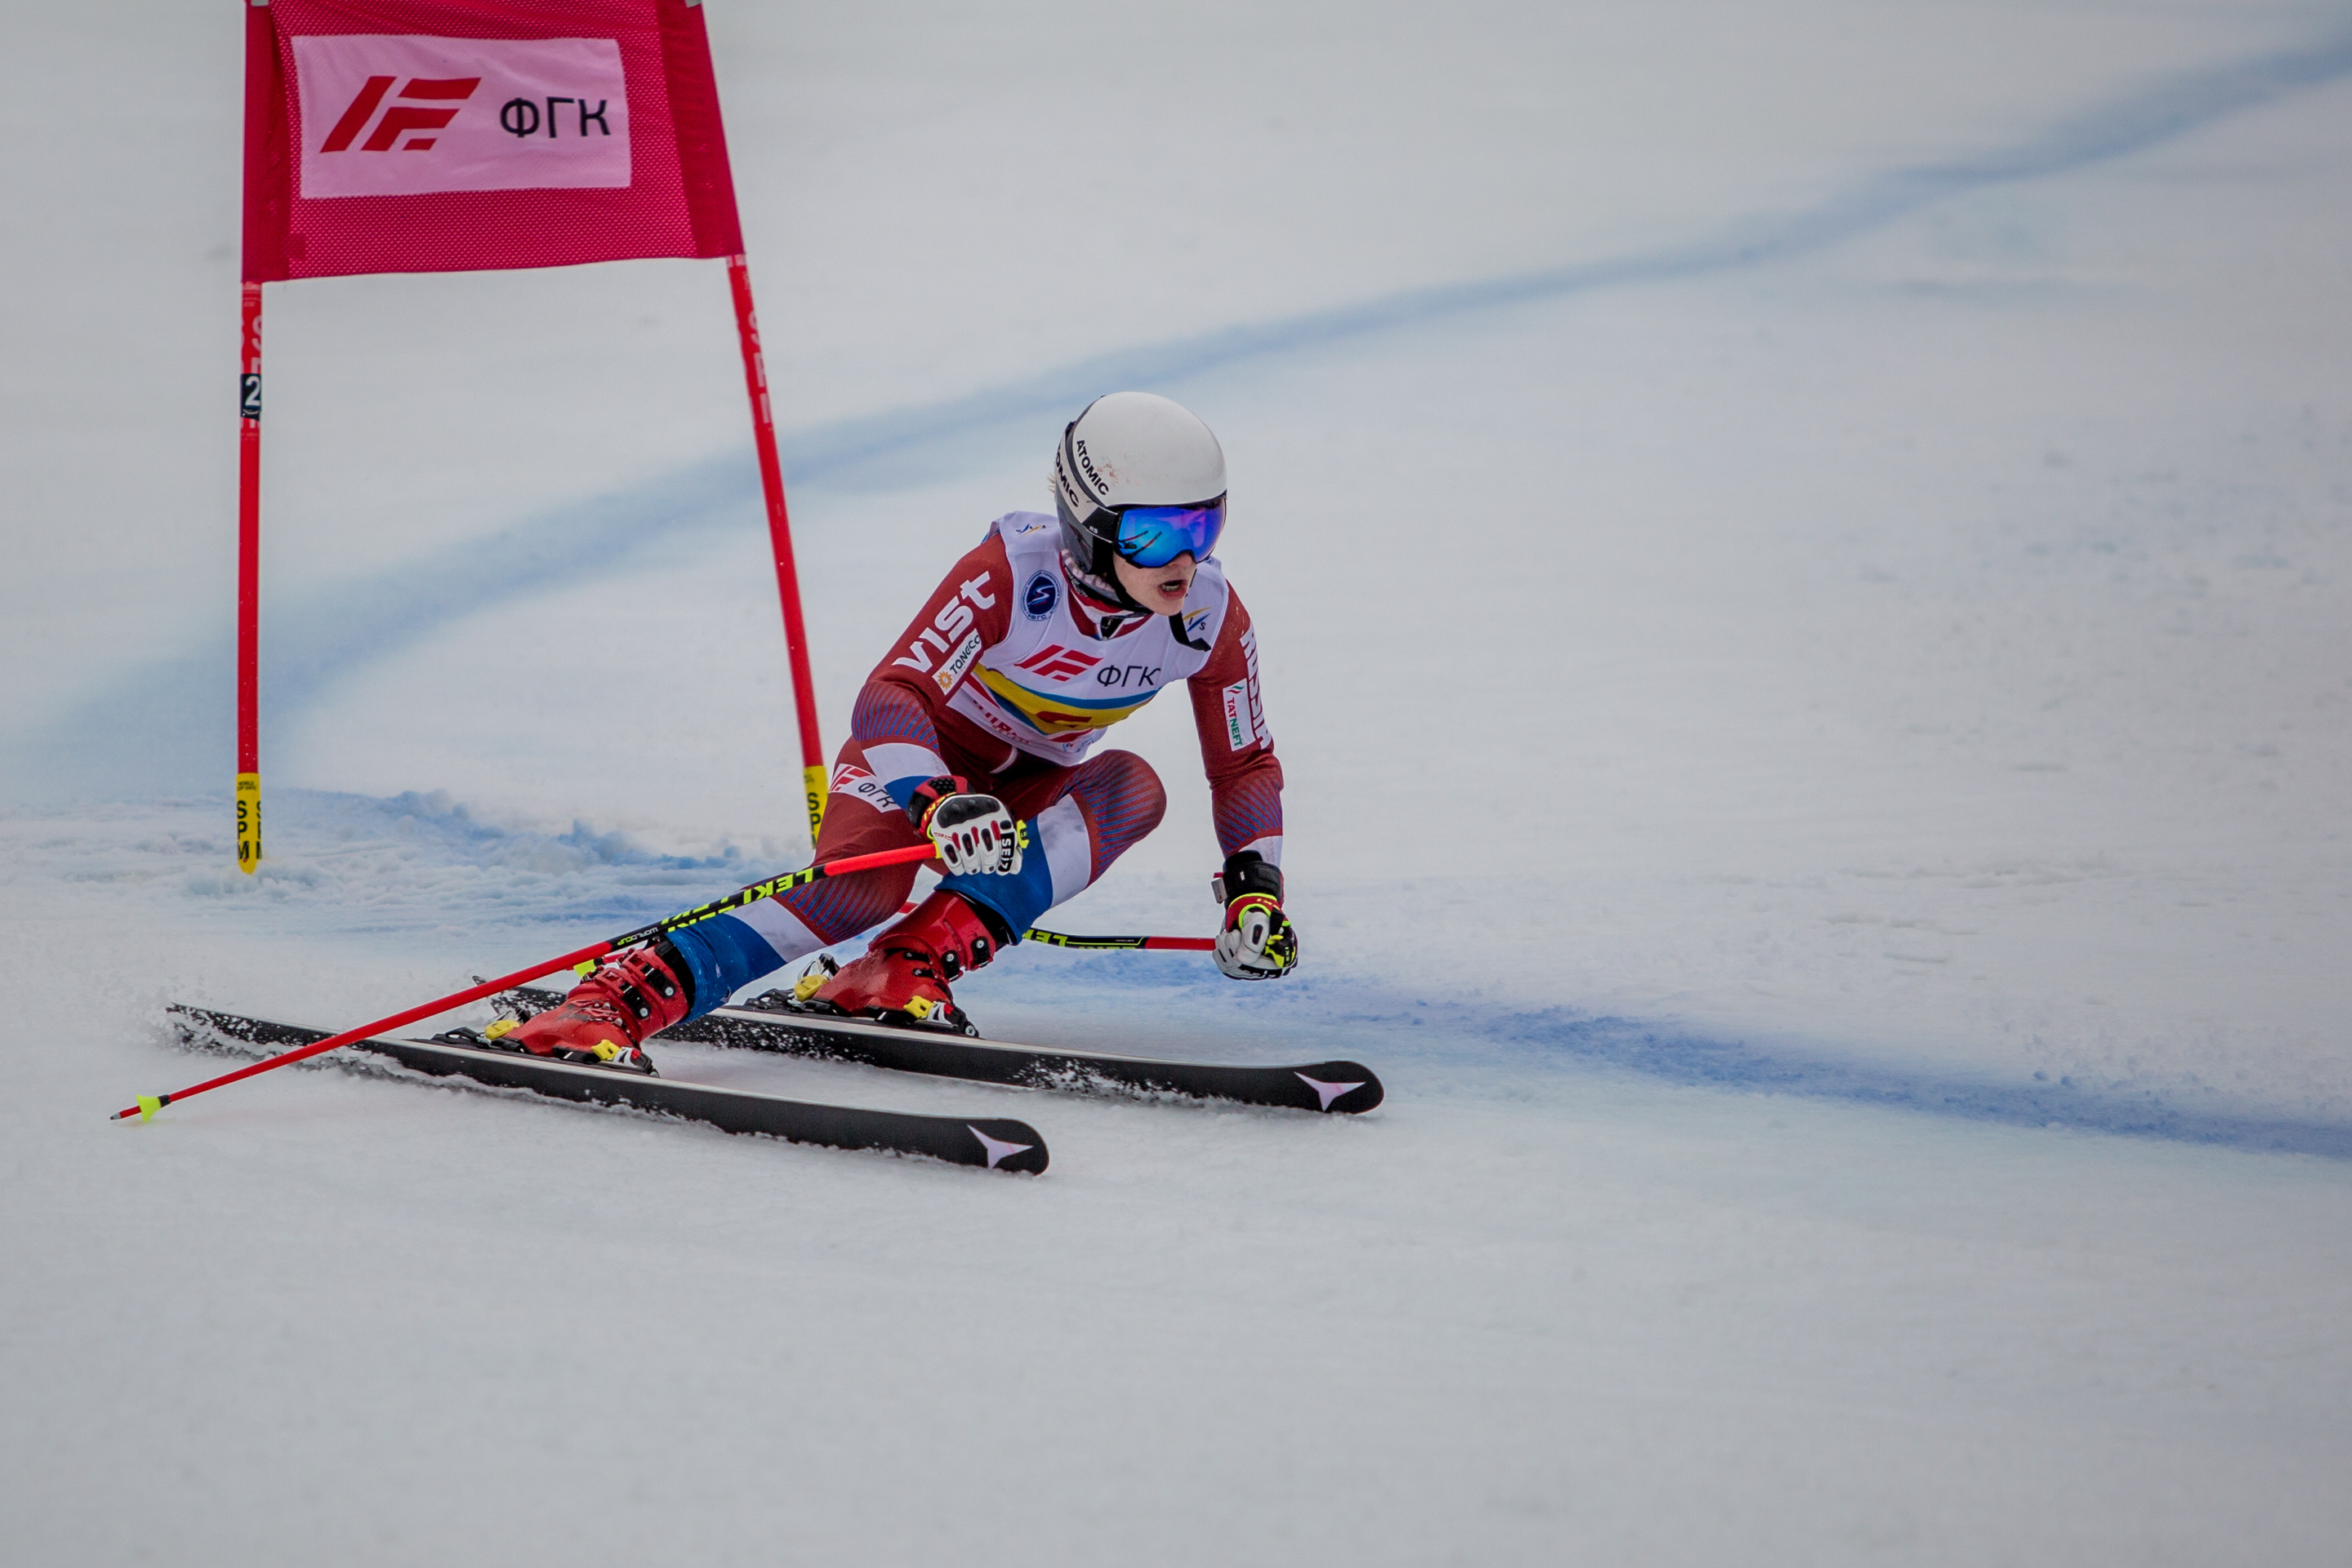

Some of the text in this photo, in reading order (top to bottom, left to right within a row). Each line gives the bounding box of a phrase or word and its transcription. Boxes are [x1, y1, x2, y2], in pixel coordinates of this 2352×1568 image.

[499, 96, 611, 139] ФГК
[1076, 439, 1110, 496] ATOMIC
[1096, 664, 1162, 688] ФГК
[1227, 697, 1244, 746] TATNEFT
[743, 867, 814, 905] LEKI
